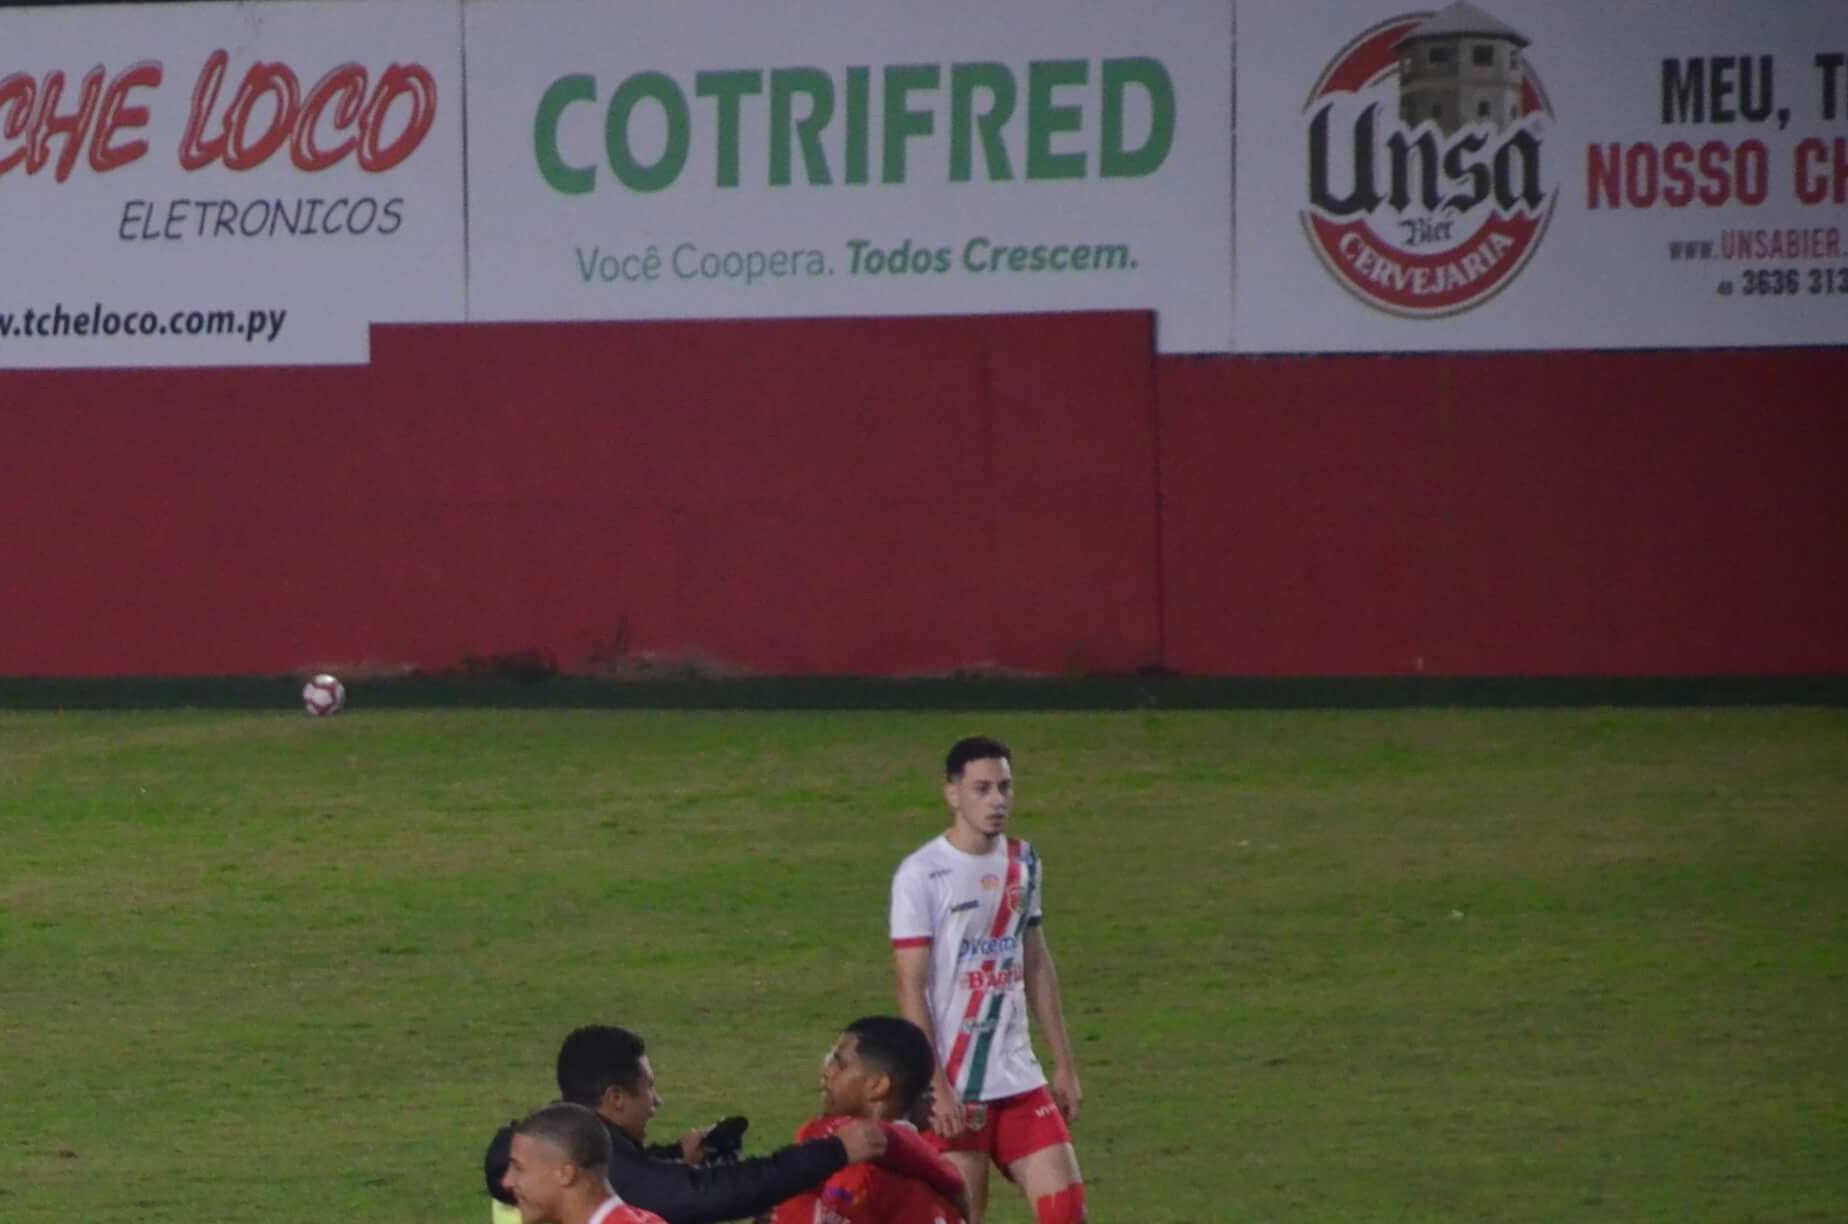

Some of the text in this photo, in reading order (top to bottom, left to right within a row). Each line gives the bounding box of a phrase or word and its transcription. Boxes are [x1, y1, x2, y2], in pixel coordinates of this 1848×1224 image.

[178, 48, 438, 175] LOCO
[534, 56, 1177, 195] COTRIFRED
[1661, 52, 1848, 130] MEU, T
[1309, 100, 1549, 215] Unsa
[1586, 138, 1769, 210] NOSSO
[118, 197, 404, 241] ELETRONICOS
[576, 236, 1139, 285] Você Coopera. Todos Crescem.
[1339, 232, 1514, 295] CERVEJARIA
